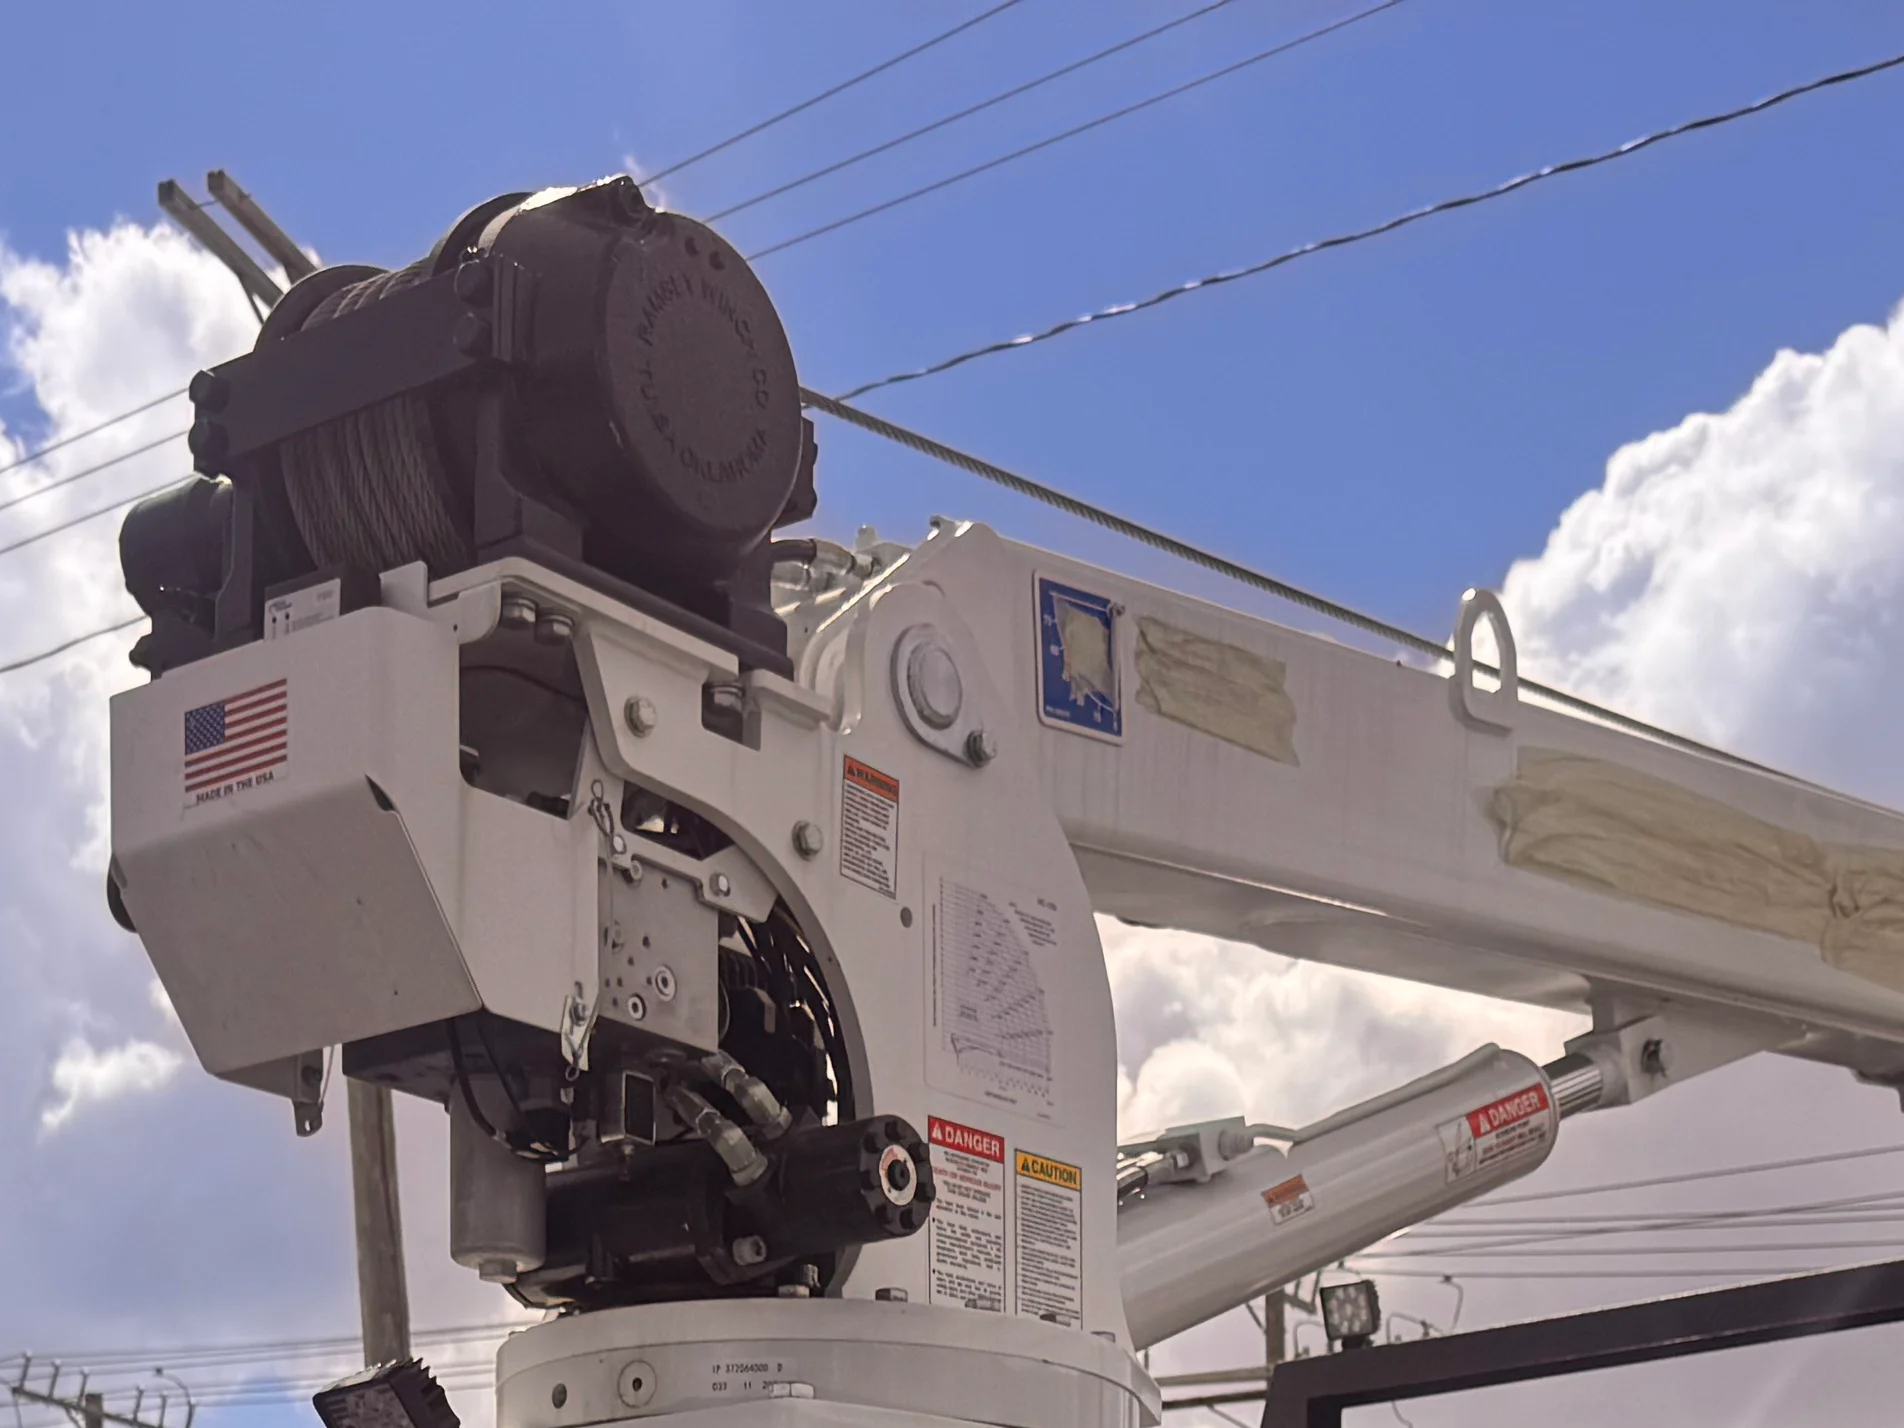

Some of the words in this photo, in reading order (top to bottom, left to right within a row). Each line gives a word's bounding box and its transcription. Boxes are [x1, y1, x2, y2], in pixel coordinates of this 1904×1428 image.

[196, 787, 222, 803] MADE
[224, 783, 233, 796] IN
[236, 777, 252, 792] THE
[255, 770, 274, 786] USA
[1487, 1091, 1541, 1127] DANGER
[945, 1127, 1001, 1157] DANGER
[1031, 1161, 1078, 1184] CAUTION
